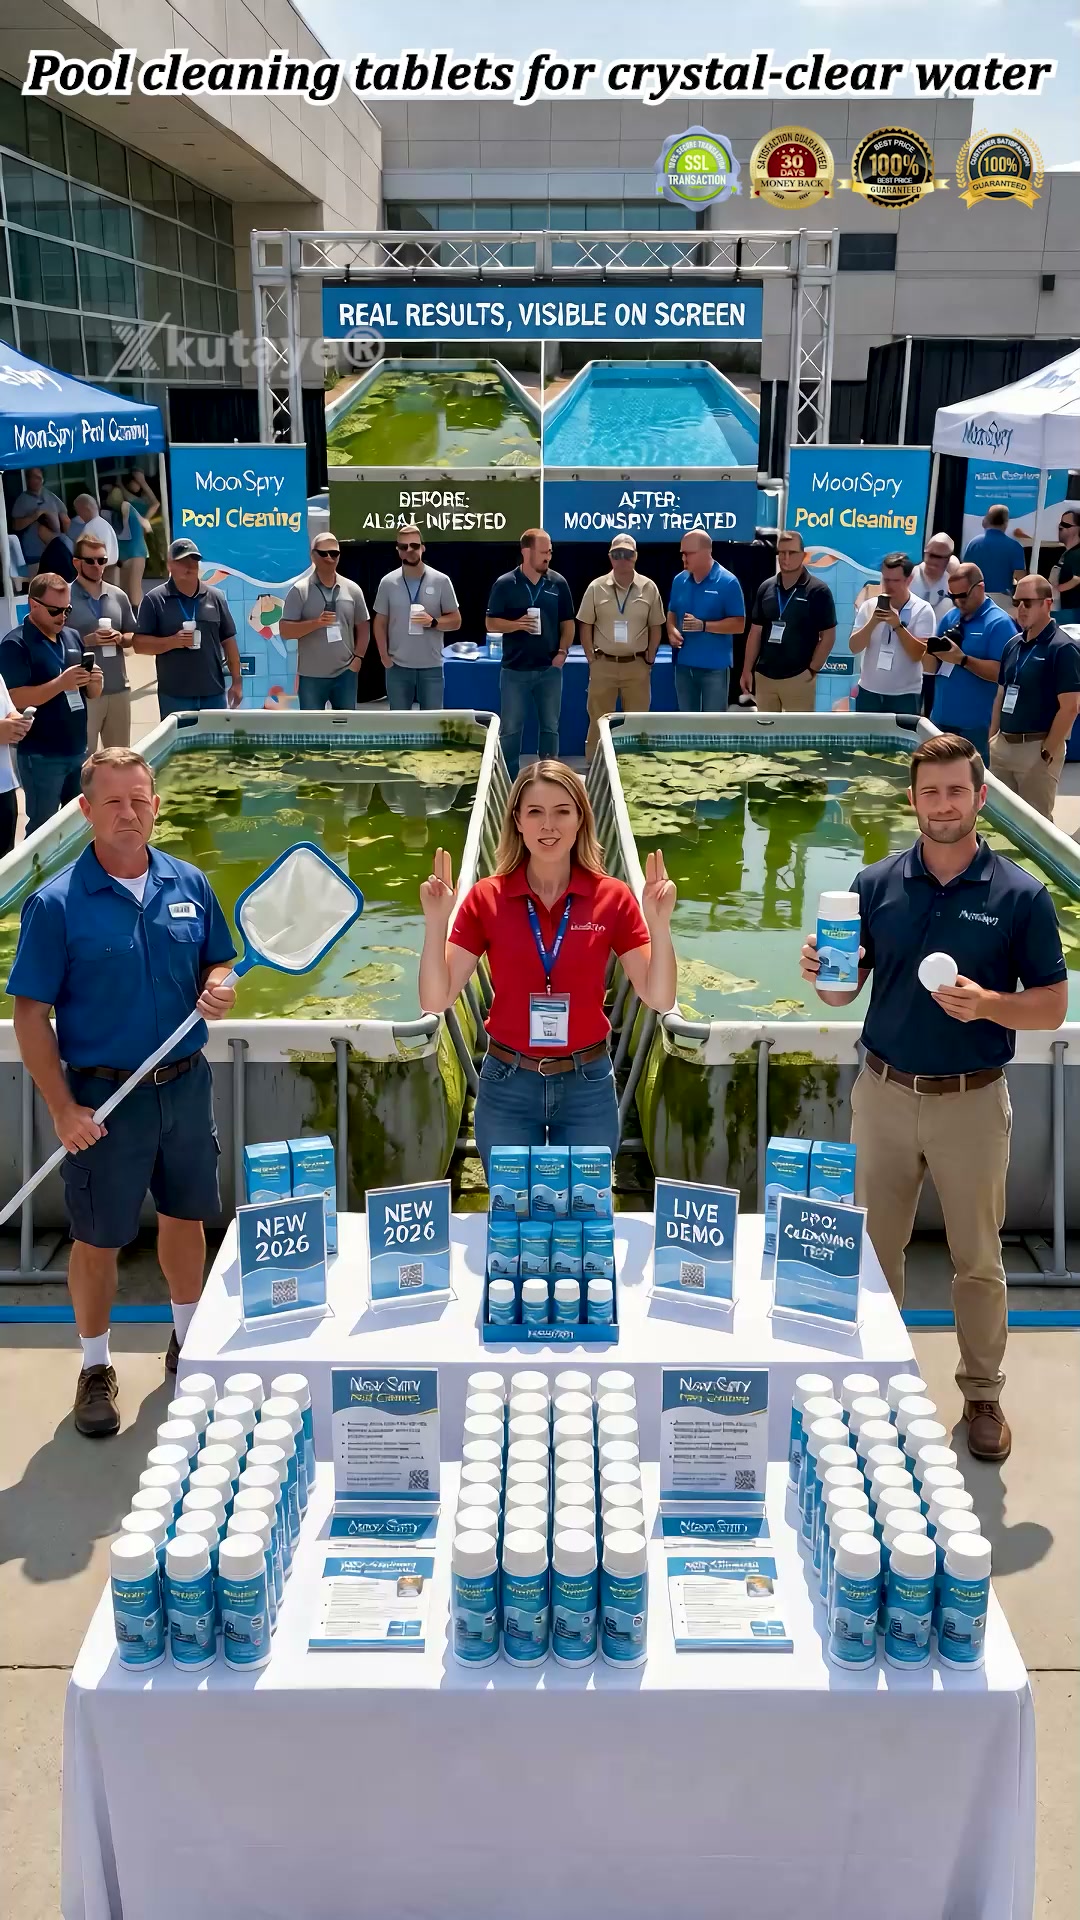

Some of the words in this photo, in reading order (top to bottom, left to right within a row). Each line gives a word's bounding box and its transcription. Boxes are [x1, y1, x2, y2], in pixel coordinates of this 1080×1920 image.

[339, 302, 398, 327] REAL
[405, 302, 512, 332] RESULTS,
[519, 302, 607, 327] VISIBLE
[614, 302, 647, 326] ON
[654, 302, 746, 326] SCREEN
[181, 507, 220, 528] Pool
[795, 507, 834, 528] Pool
[839, 508, 918, 535] Cleaning
[383, 1200, 434, 1226] NEW
[673, 1198, 720, 1223] LIVE
[256, 1212, 307, 1239] NEW
[383, 1221, 436, 1247] 2026
[666, 1221, 725, 1247] DEMO
[255, 1235, 310, 1262] 2026
